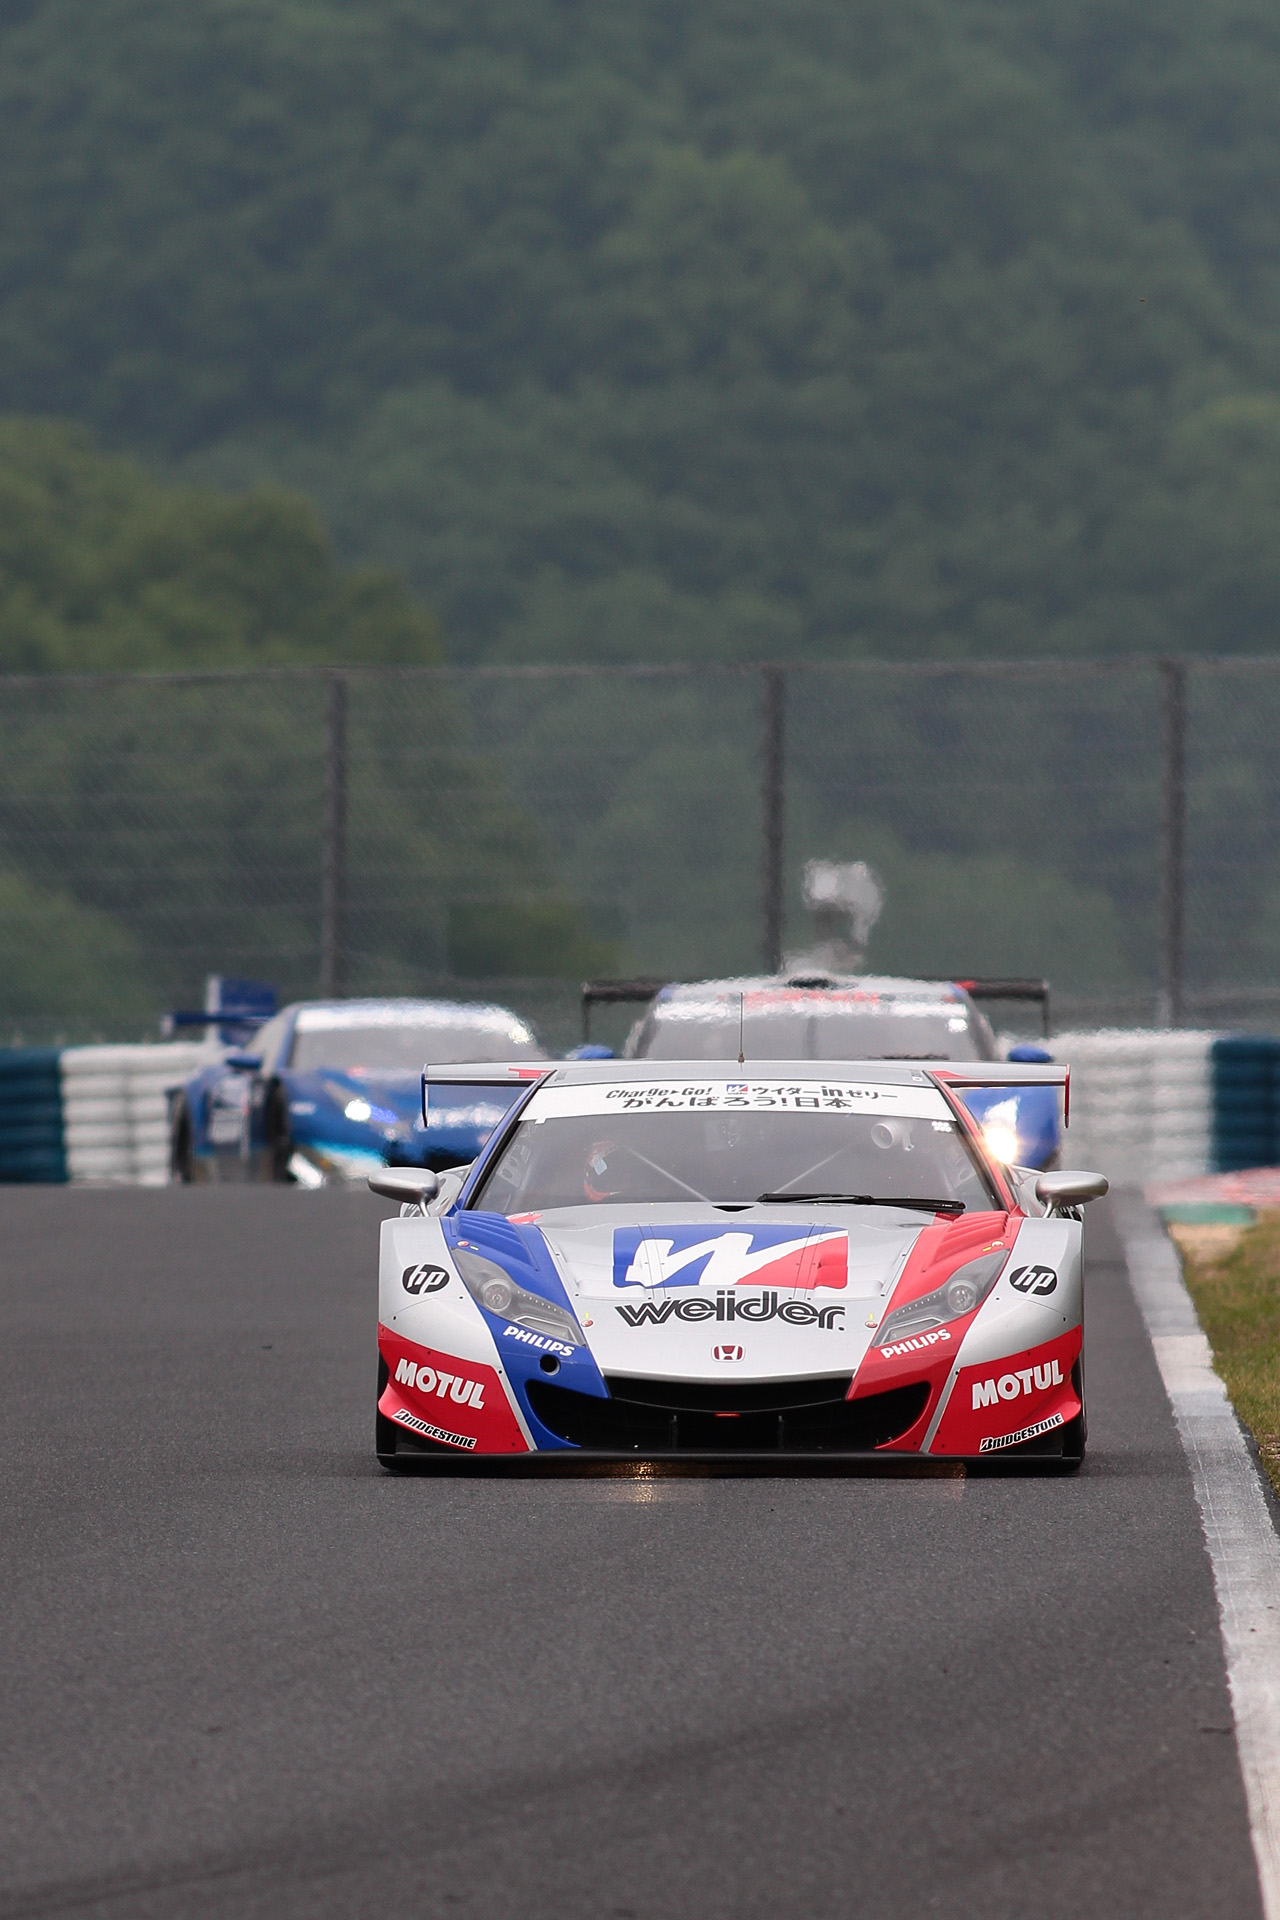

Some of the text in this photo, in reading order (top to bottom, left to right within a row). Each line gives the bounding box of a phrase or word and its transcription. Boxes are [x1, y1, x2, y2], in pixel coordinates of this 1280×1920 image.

[622, 1096, 853, 1109] がんばろう!日本
[406, 1263, 447, 1295] hp
[1012, 1264, 1056, 1296] hp
[503, 1325, 575, 1356] PHILIPS
[880, 1328, 952, 1359] PHILIPS
[394, 1357, 485, 1410] MOTUL
[971, 1359, 1064, 1410] MOTUL
[393, 1409, 477, 1449] BRIDGESTONE
[980, 1413, 1064, 1452] BRIDGESTONE
